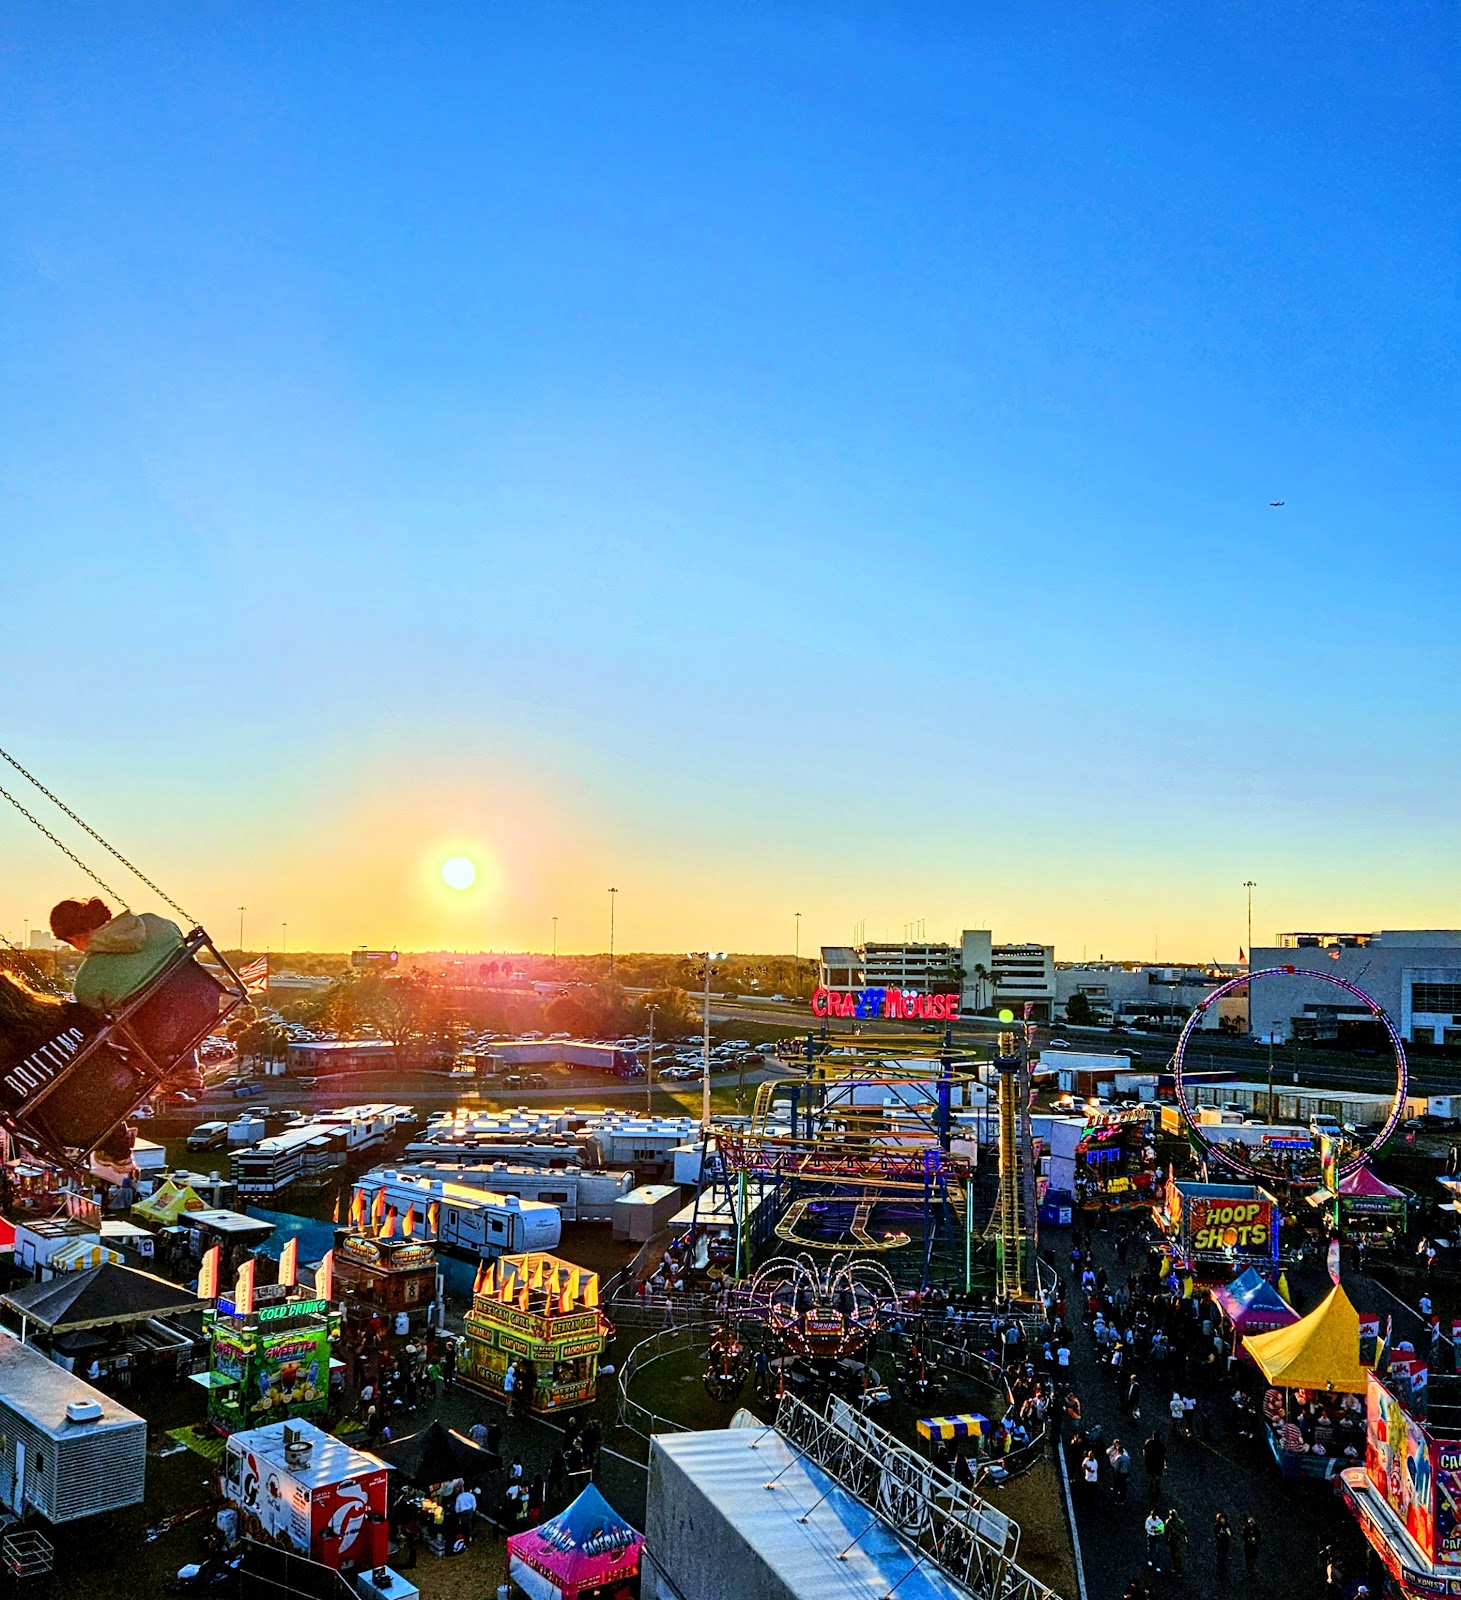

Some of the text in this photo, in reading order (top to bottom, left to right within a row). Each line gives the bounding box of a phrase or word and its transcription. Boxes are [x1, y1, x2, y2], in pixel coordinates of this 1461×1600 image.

[812, 986, 960, 1021] CRAZY MOUSE
[1206, 1204, 1260, 1225] HOOP
[1194, 1224, 1267, 1249] SHOTS
[260, 1307, 287, 1320] COLD
[287, 1299, 327, 1317] DRINKS
[477, 1301, 530, 1329] MEXICAN GRILL
[552, 1315, 597, 1334] MEXICAN GRILL
